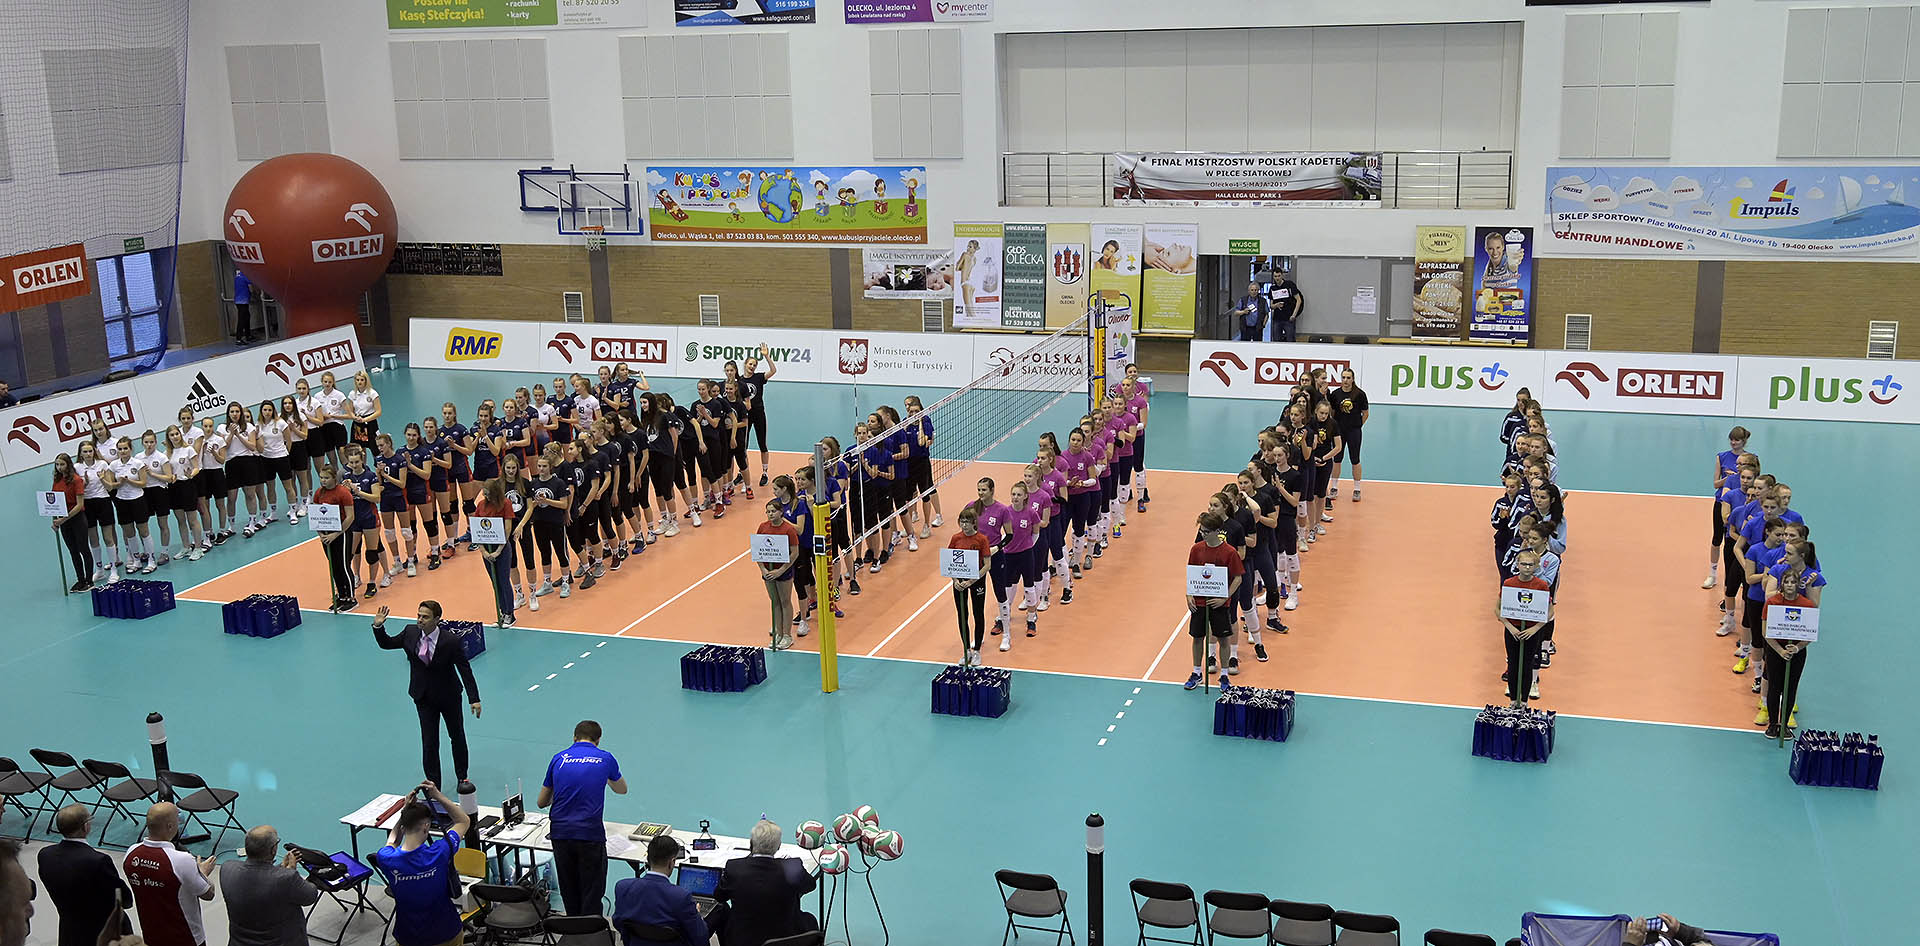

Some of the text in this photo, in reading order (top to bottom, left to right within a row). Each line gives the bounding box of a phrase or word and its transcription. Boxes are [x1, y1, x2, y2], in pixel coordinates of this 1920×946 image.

[399, 8, 484, 23] Kasę Stefczyka!
[510, 11, 529, 19] karty
[848, 4, 874, 12] OLECKO,
[885, 3, 910, 12] Jeziorna
[951, 2, 988, 12] mycenter
[1151, 157, 1348, 166] FINAŁ MISTRZOSTW POLSKI KADETEK
[674, 172, 721, 189] Kubuś
[1740, 202, 1800, 219] Impuls
[657, 232, 678, 240] Olecko,
[1558, 212, 1589, 221] SKLEP
[1592, 212, 1645, 223] SPORTOWY
[1647, 218, 1664, 227] Plac
[1667, 222, 1704, 235] Wolności
[1706, 228, 1717, 237] 20
[1719, 231, 1731, 239] Al.
[1767, 239, 1778, 248] 1b
[1781, 242, 1805, 250] 19-400
[1839, 233, 1915, 249] www.impuls.olecko.pl
[317, 238, 381, 258] ORLEN
[1555, 230, 1684, 250] CENTRUM HANDLOWE
[1007, 246, 1026, 254] GŁOS
[1006, 254, 1044, 264] OLECKA
[1419, 262, 1459, 270] ZAPRASZAMY
[19, 262, 79, 289] ORLEN
[450, 335, 500, 355] RMF
[594, 340, 664, 360] ORLEN
[874, 347, 932, 357] Ministerstwo
[302, 343, 352, 373] ORLEN
[703, 345, 812, 363] SPORTOWY24
[873, 360, 902, 370] Sportu
[912, 361, 953, 371] Turystyki
[1021, 364, 1082, 376] SIATKÓWKA
[1390, 355, 1474, 396] plus
[1621, 372, 1717, 396] ORLEN
[1768, 366, 1863, 410] plus
[184, 394, 227, 413] adidas
